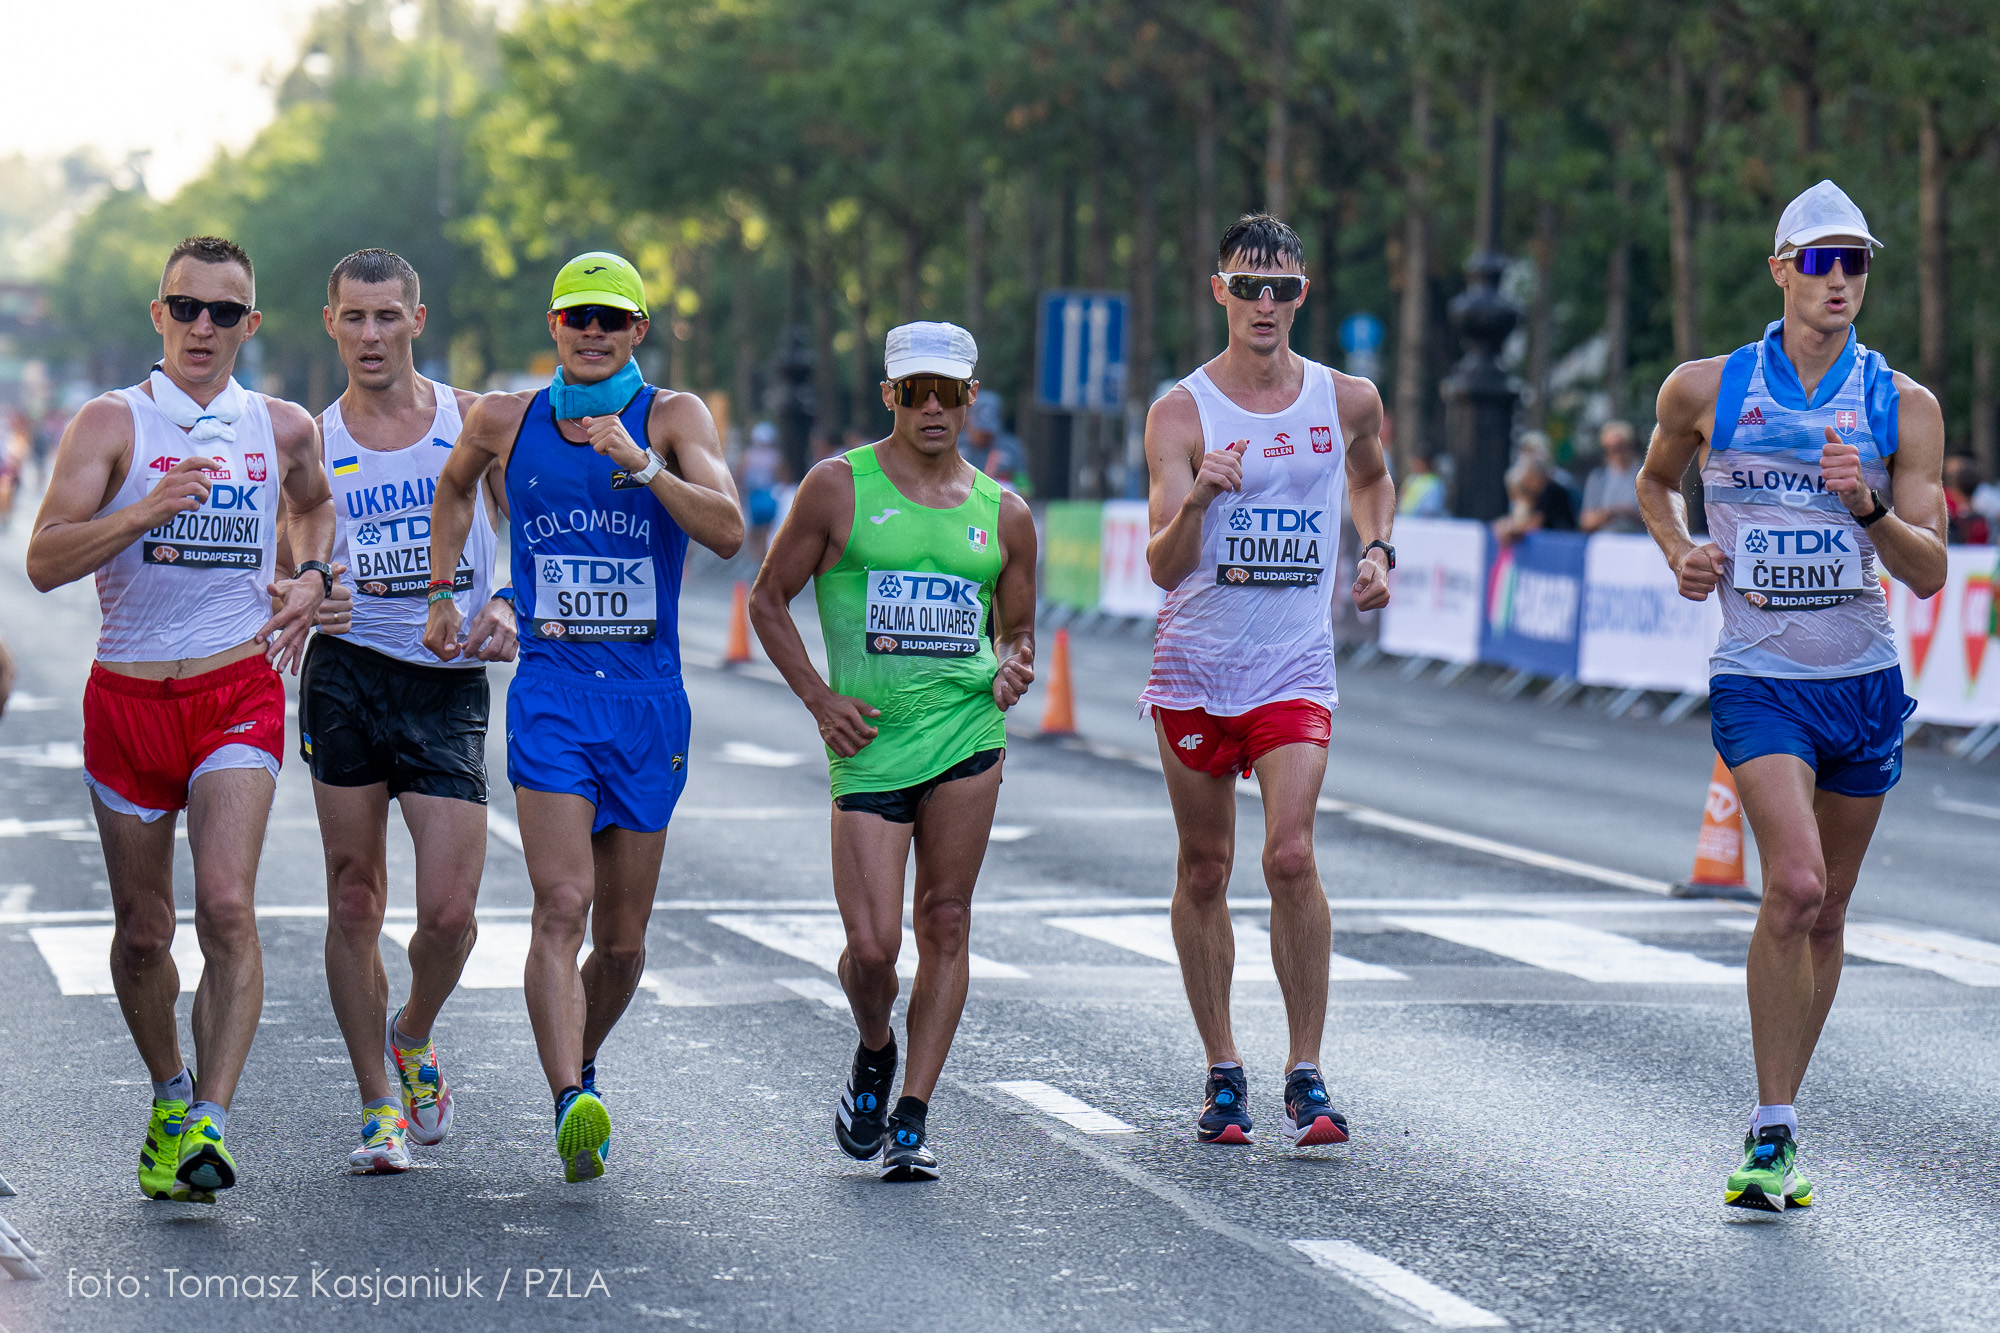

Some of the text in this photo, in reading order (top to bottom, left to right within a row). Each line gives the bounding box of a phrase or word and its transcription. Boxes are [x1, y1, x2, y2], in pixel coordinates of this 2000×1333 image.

[1738, 415, 1766, 425] adidas
[1264, 447, 1293, 457] ORLEN
[202, 470, 230, 480] RLEN
[1732, 471, 1838, 496] SLOVAK
[346, 476, 439, 519] UKRAIN
[380, 515, 431, 542] TD
[524, 509, 650, 545] COLOMBIA
[1252, 508, 1323, 534] TDK
[1226, 537, 1320, 564] TOMALA
[1768, 529, 1851, 555] TDK
[183, 550, 256, 563] BUDAPEST 23
[357, 546, 469, 577] BANZE
[391, 576, 468, 592] BUDAP 23
[562, 559, 645, 585] TDK
[1254, 571, 1305, 582] BUDAPEST
[1753, 559, 1845, 589] ČERNÝ
[558, 591, 628, 617] SOTO
[903, 576, 976, 606] TDK
[1771, 596, 1838, 606] BUDAPEST
[568, 625, 648, 635] BUDAPEST 23
[870, 604, 977, 636] PALMA OLIVARES
[901, 640, 976, 653] BUDAPEST 23
[1177, 733, 1203, 750] 4F
